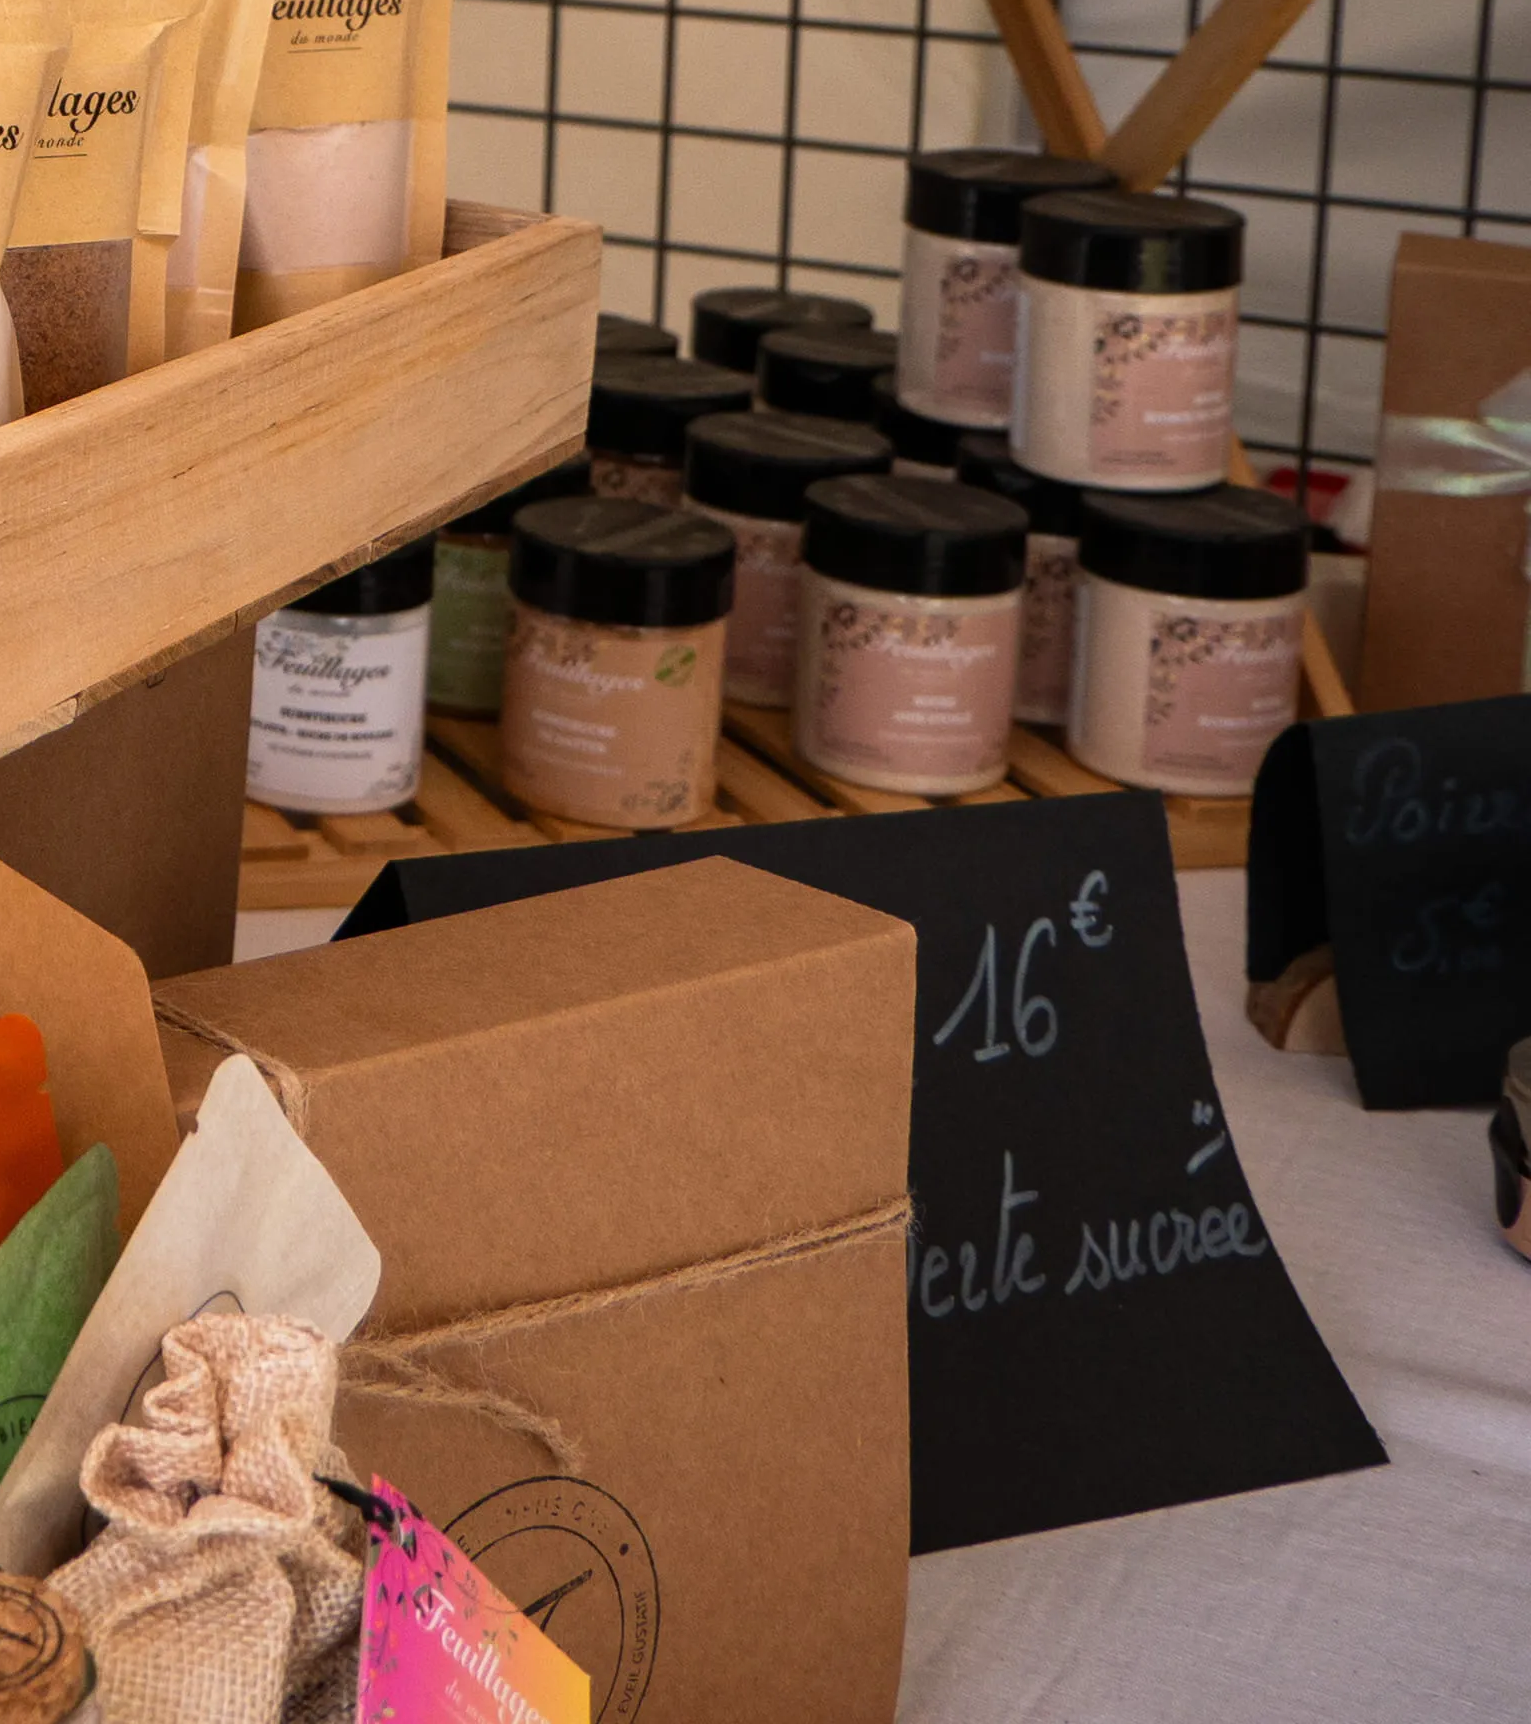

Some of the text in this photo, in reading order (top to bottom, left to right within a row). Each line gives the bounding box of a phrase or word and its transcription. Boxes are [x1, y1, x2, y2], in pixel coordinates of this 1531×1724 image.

[47, 77, 140, 133] lages
[907, 1149, 1047, 1319] erte
[414, 1588, 552, 1724] Feuillage
[631, 1590, 648, 1665] GUSTATIF
